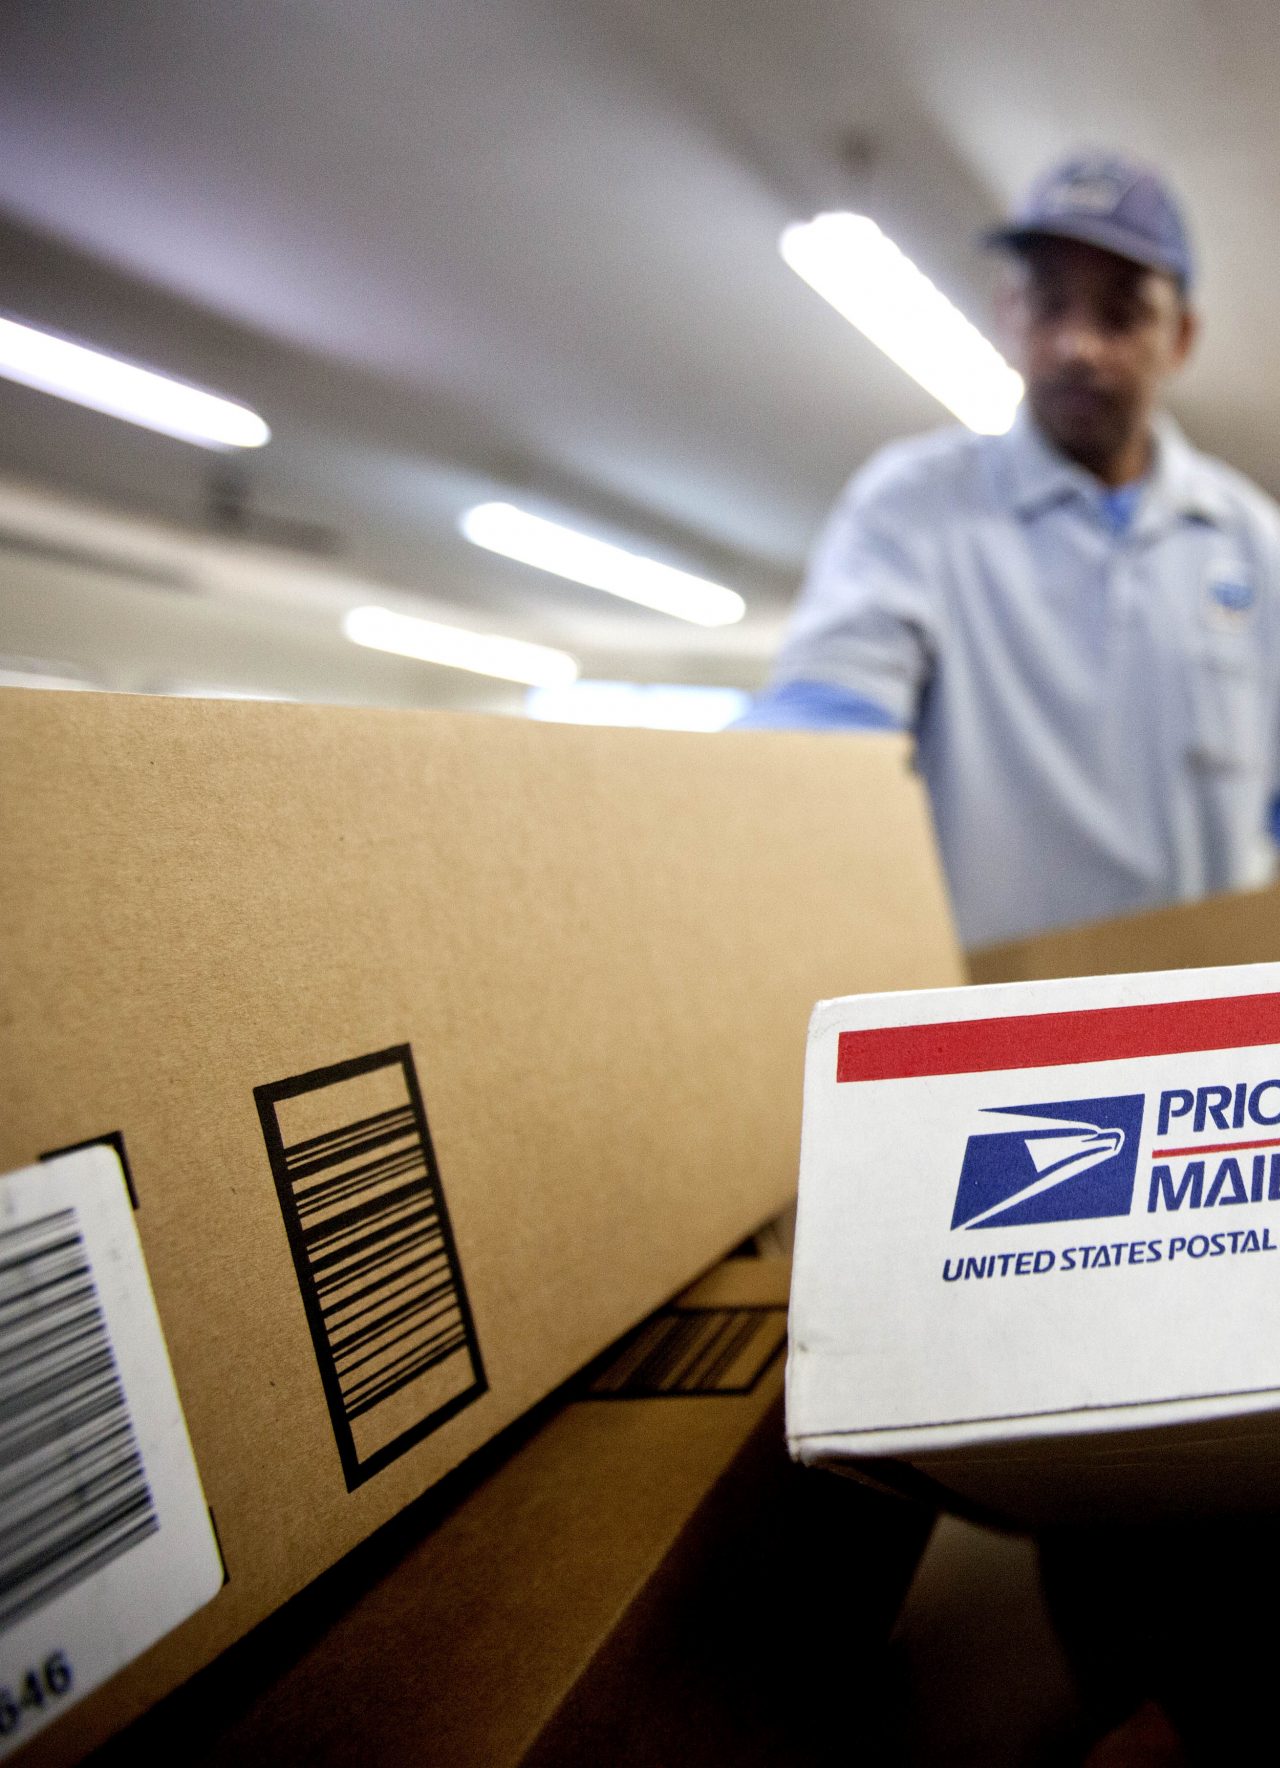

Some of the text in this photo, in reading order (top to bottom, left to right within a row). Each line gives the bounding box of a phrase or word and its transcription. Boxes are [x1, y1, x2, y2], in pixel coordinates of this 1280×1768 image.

[941, 1249, 1057, 1283] UNITED
[1059, 1239, 1163, 1272] STATES
[1167, 1227, 1278, 1262] POSTAL
